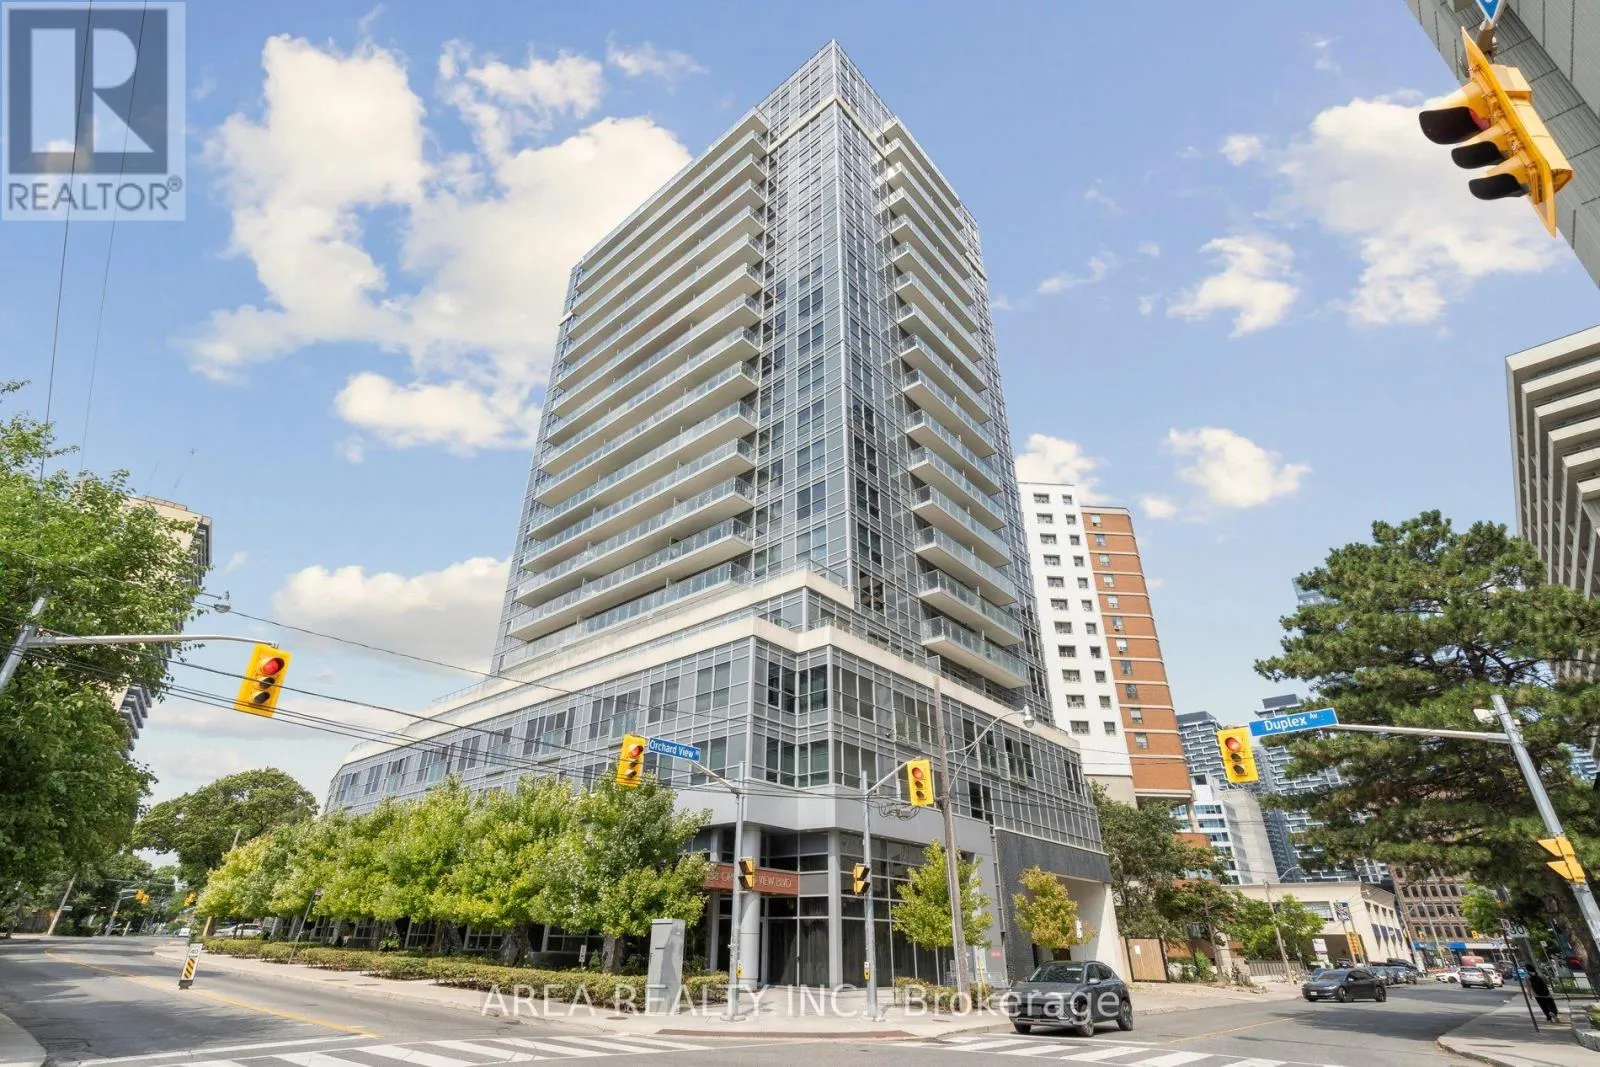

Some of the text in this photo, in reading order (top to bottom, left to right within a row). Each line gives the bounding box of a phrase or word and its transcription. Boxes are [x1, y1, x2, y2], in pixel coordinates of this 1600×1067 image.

[1264, 716, 1307, 731] Duplex
[649, 740, 694, 758] Orchard View
